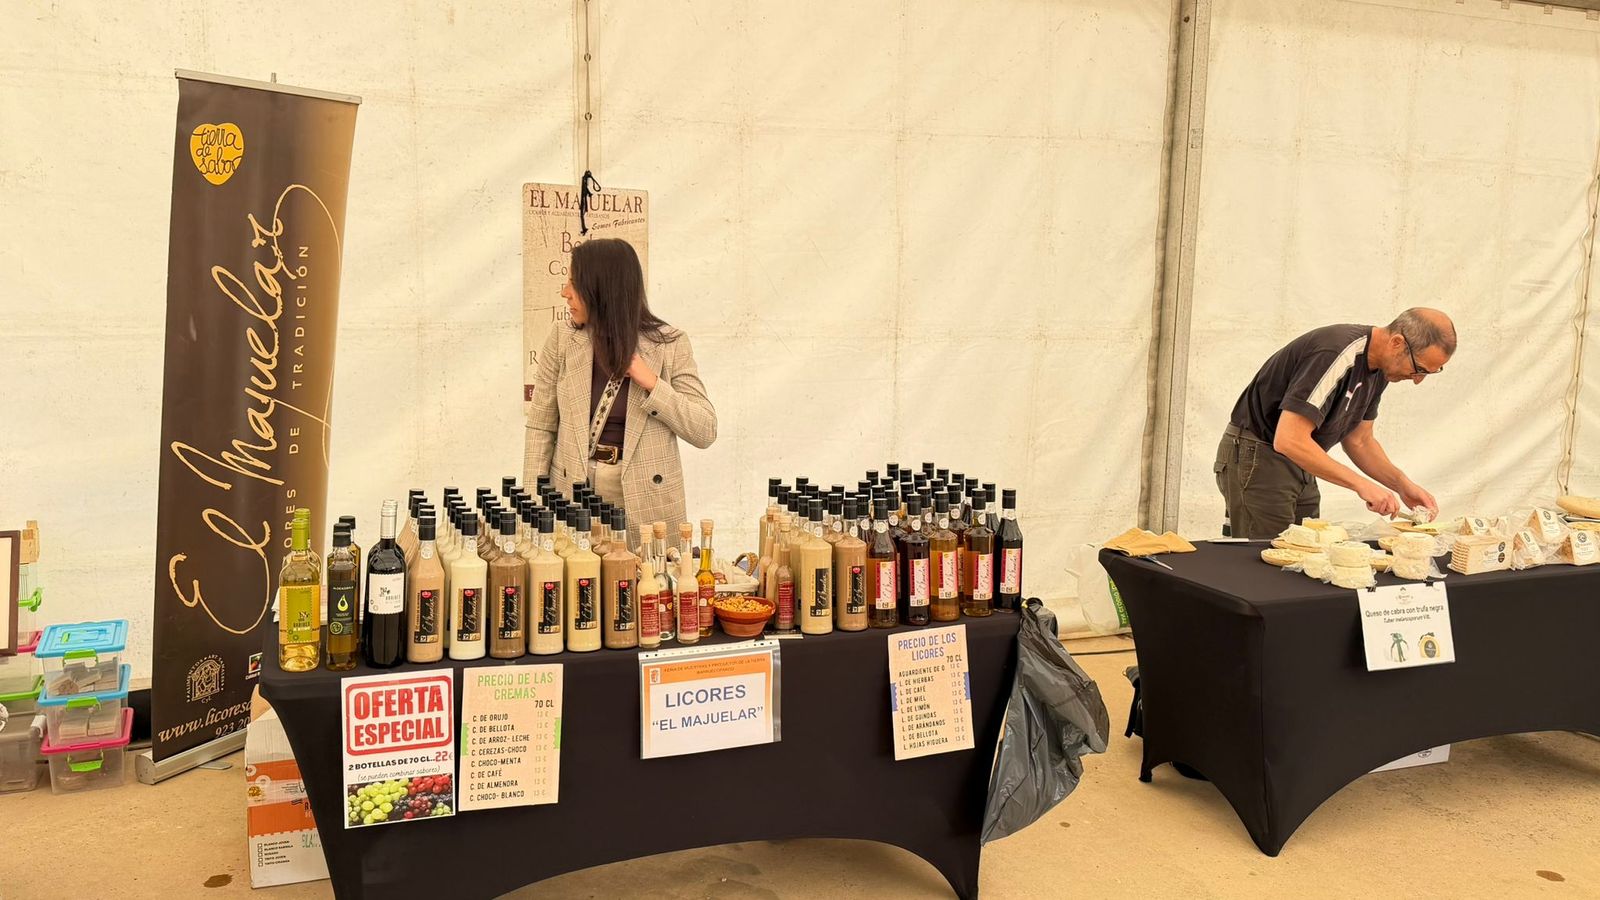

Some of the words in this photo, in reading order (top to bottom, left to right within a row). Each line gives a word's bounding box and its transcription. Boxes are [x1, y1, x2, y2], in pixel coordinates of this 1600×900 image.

[192, 127, 242, 150] tierra
[196, 145, 211, 157] de
[530, 189, 550, 209] EL
[555, 190, 643, 214] MAUELAR
[591, 222, 612, 231] Somos
[612, 217, 646, 228] Fabricantes
[292, 245, 309, 389] TRADICIÓN
[289, 426, 300, 455] DE
[283, 488, 297, 550] ORES
[168, 508, 271, 635] El
[1365, 610, 1382, 618] Queso
[1416, 605, 1429, 613] trufa
[1429, 605, 1444, 613] negra
[898, 637, 926, 650] PRECIO
[929, 635, 940, 646] DE
[941, 632, 957, 644] LOS
[912, 647, 945, 661] LICORES
[946, 655, 954, 663] 70
[899, 667, 932, 677] AGUARDIENTE
[477, 673, 514, 687] PRECIO
[518, 673, 530, 685] DE
[534, 672, 553, 684] LAS
[913, 676, 934, 685] HIERBAS
[494, 687, 536, 700] CREMAS
[665, 684, 746, 708] LICORES
[354, 685, 444, 720] OFERTA
[535, 700, 544, 708] 70
[546, 700, 554, 708] CL
[480, 714, 487, 722] DE
[489, 713, 509, 721] ORUJO
[652, 718, 677, 731] “EL
[681, 706, 764, 728] MAJUELAR”
[215, 722, 234, 738] 923
[354, 717, 445, 747] ESPECIAL
[916, 730, 938, 739] BELLOTA
[488, 736, 511, 744] ARROZ-
[479, 746, 527, 756] CEREZAS-CHOCO
[355, 759, 397, 770] BOTELLAS
[478, 757, 521, 767] CHOCO-MENTA
[389, 769, 415, 778] combinar
[477, 782, 485, 790] DE
[487, 780, 518, 789] ALMENDRA
[477, 793, 499, 801] CHOCO-
[501, 790, 524, 798] BLANCO
